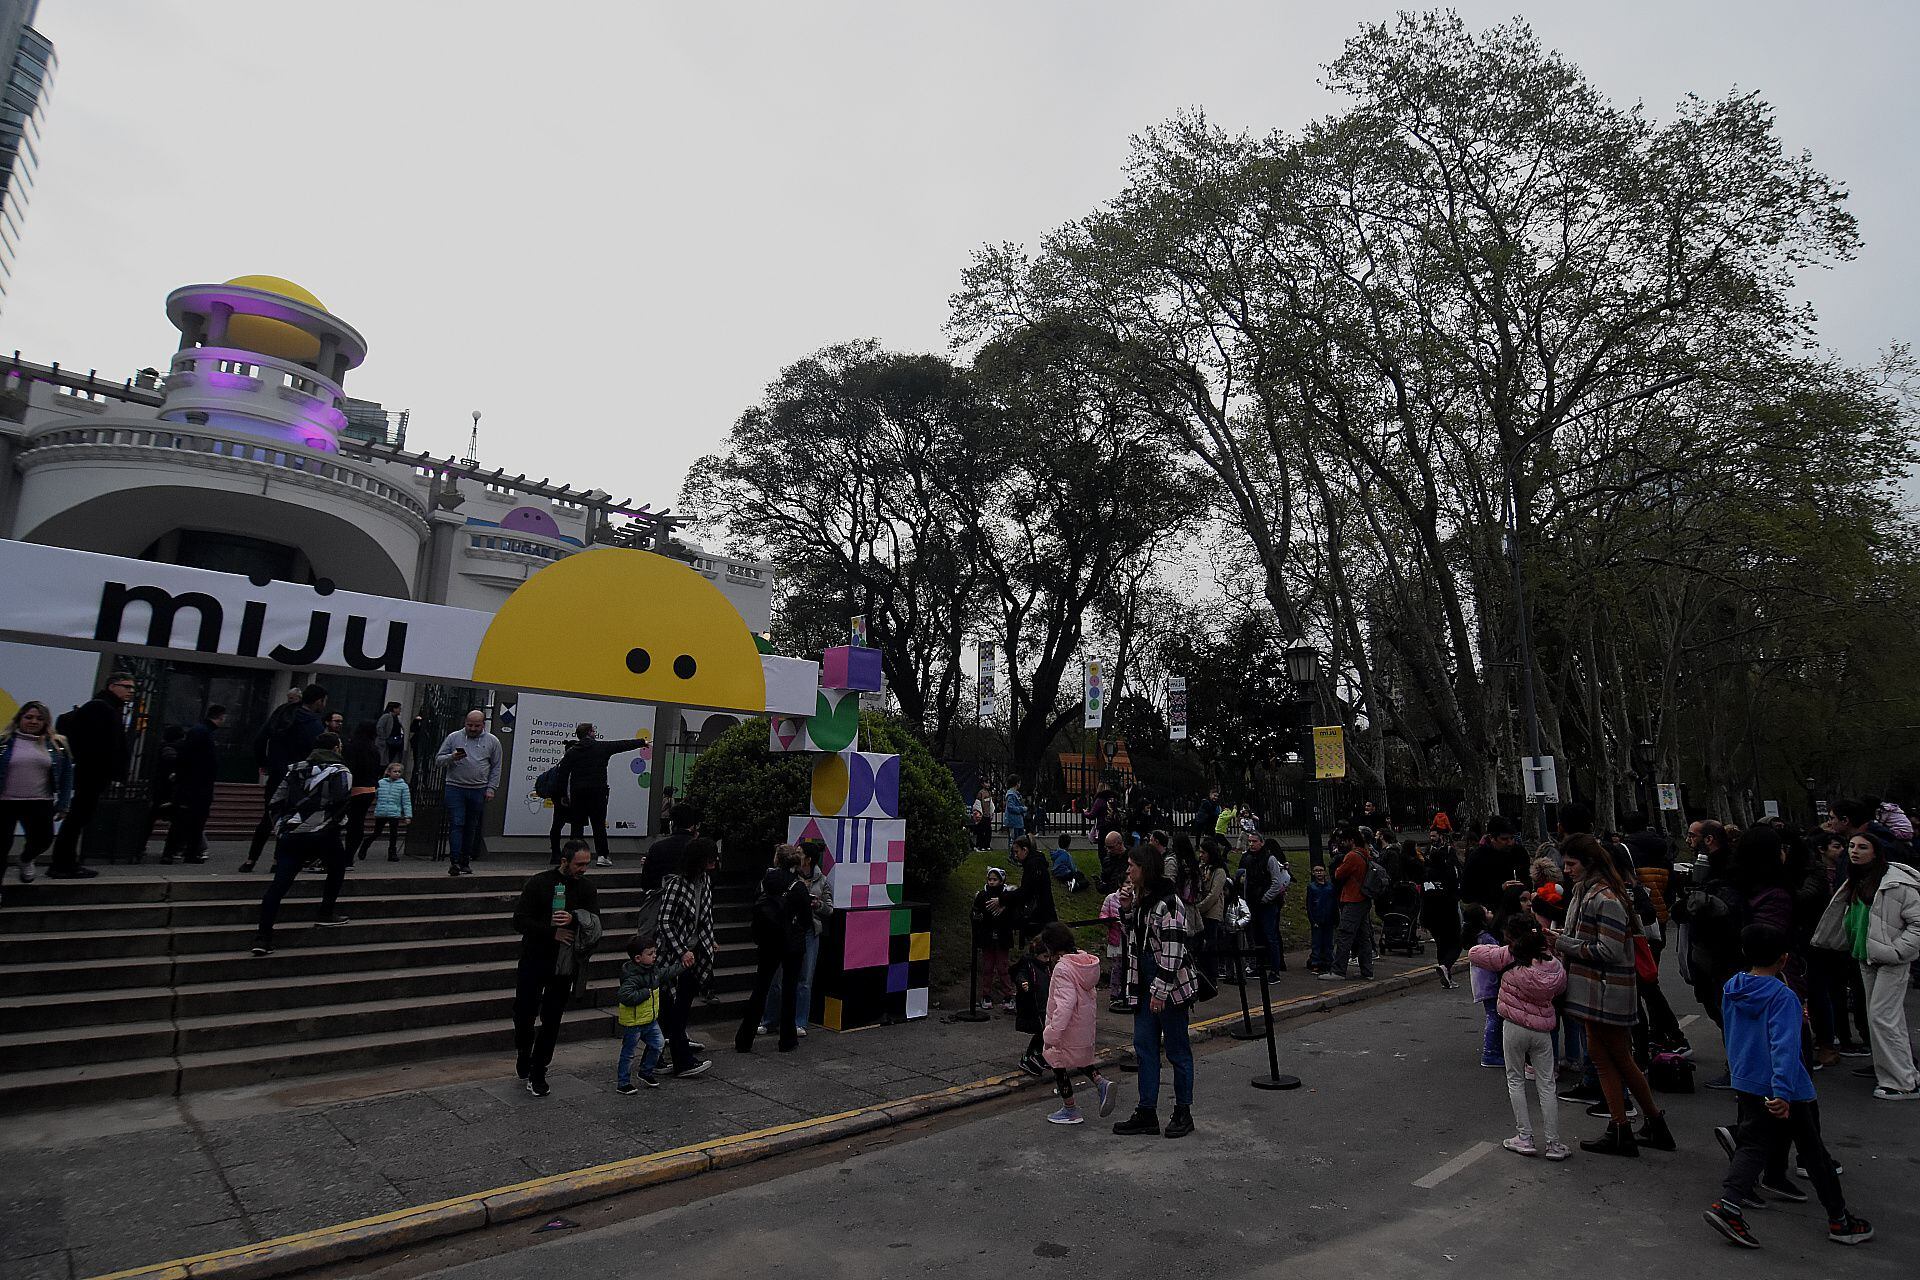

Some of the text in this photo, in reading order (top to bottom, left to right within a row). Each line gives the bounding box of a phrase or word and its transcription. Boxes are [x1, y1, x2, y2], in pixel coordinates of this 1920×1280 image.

[94, 566, 408, 673] miju
[532, 718, 543, 726] Un
[544, 721, 574, 730] espacio
[530, 728, 564, 737] pensado
[1319, 728, 1337, 737] miju
[529, 737, 548, 745] para
[529, 746, 561, 755] derecho
[528, 755, 561, 764] todos lo
[527, 764, 538, 772] de
